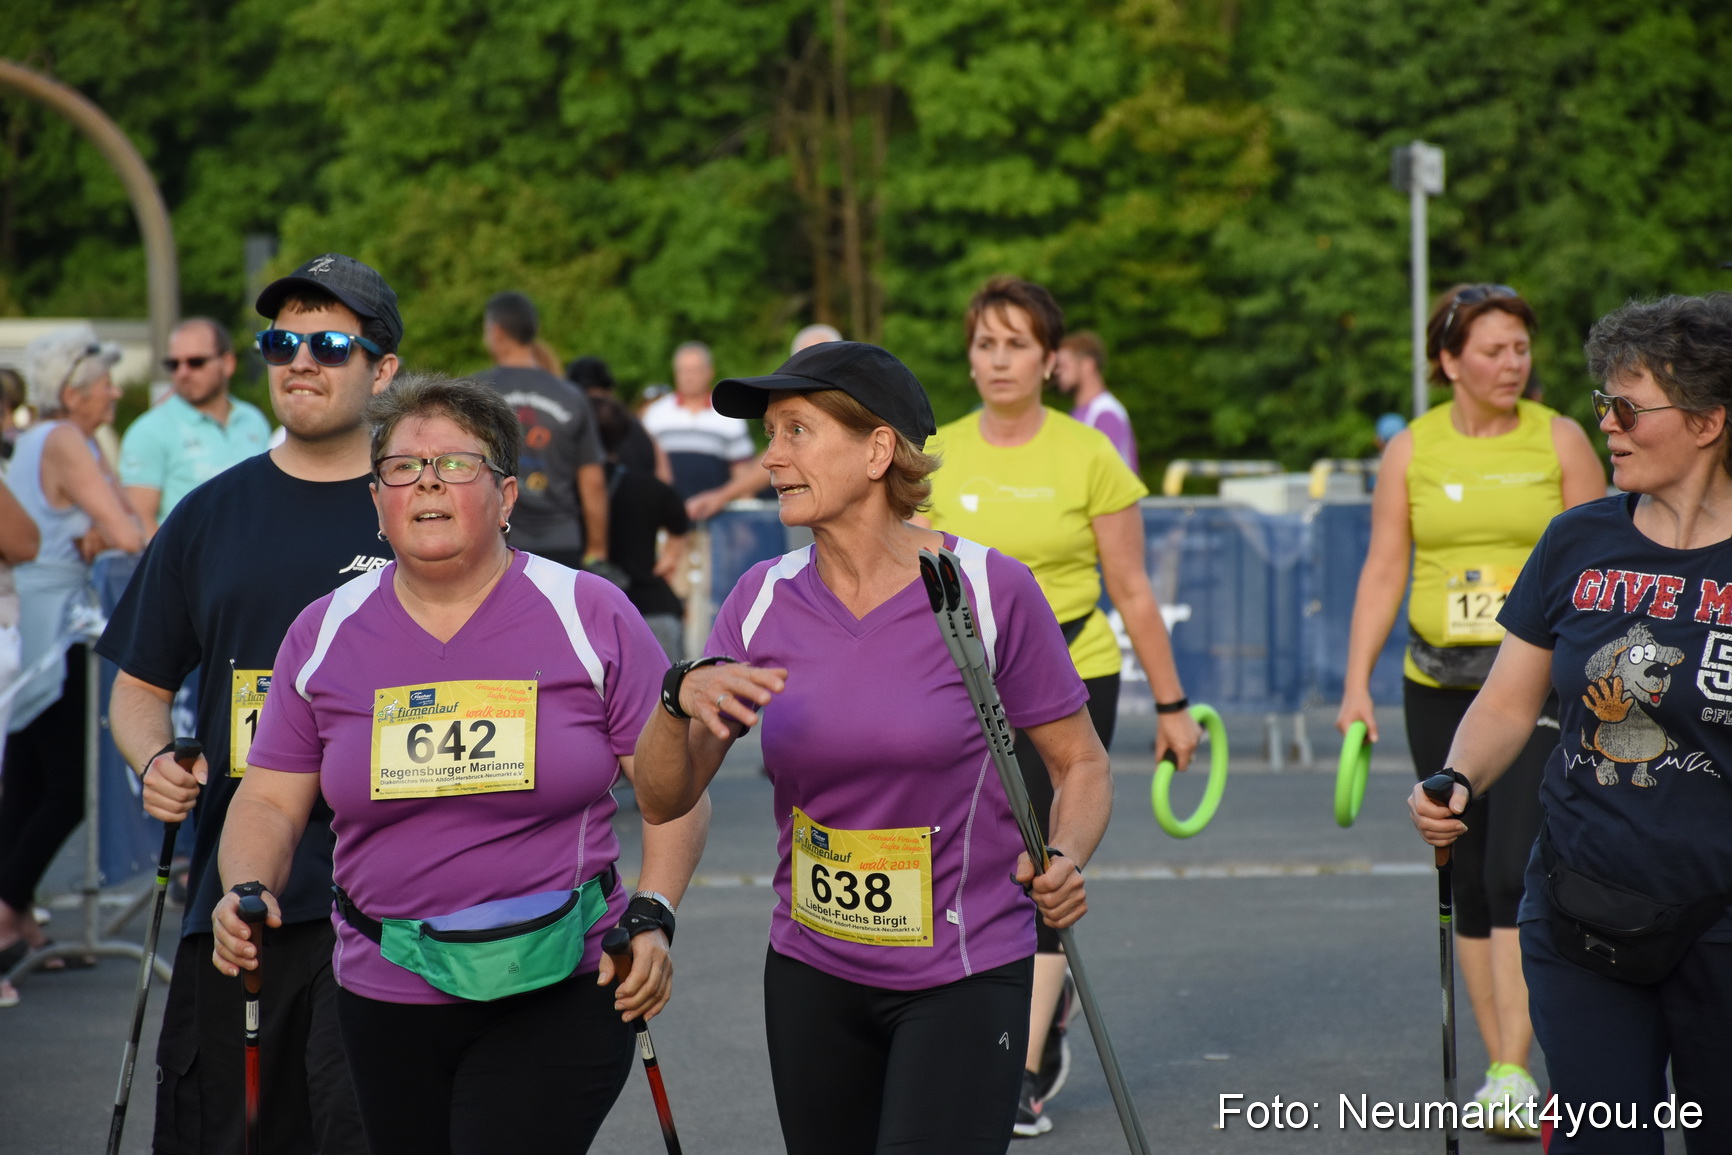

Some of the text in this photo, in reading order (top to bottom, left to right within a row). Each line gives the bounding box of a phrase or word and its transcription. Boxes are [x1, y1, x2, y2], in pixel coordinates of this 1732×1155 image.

[1572, 569, 1732, 626] GIVE M
[962, 606, 975, 638] LEKI
[248, 690, 266, 701] firm
[398, 702, 460, 718] firmenlauf
[466, 706, 525, 718] walk 2019
[245, 709, 258, 745] 1
[992, 704, 1016, 756] LEKI
[406, 720, 496, 764] 642
[380, 761, 524, 780] Regensburger Marianne
[380, 777, 419, 786] Diakonisches
[804, 838, 852, 863] firmenlauf
[860, 858, 920, 870] walk 2019
[812, 864, 892, 914] 638
[806, 898, 907, 928] Liebel-Fuchs Birgit
[822, 916, 832, 924] Werk
